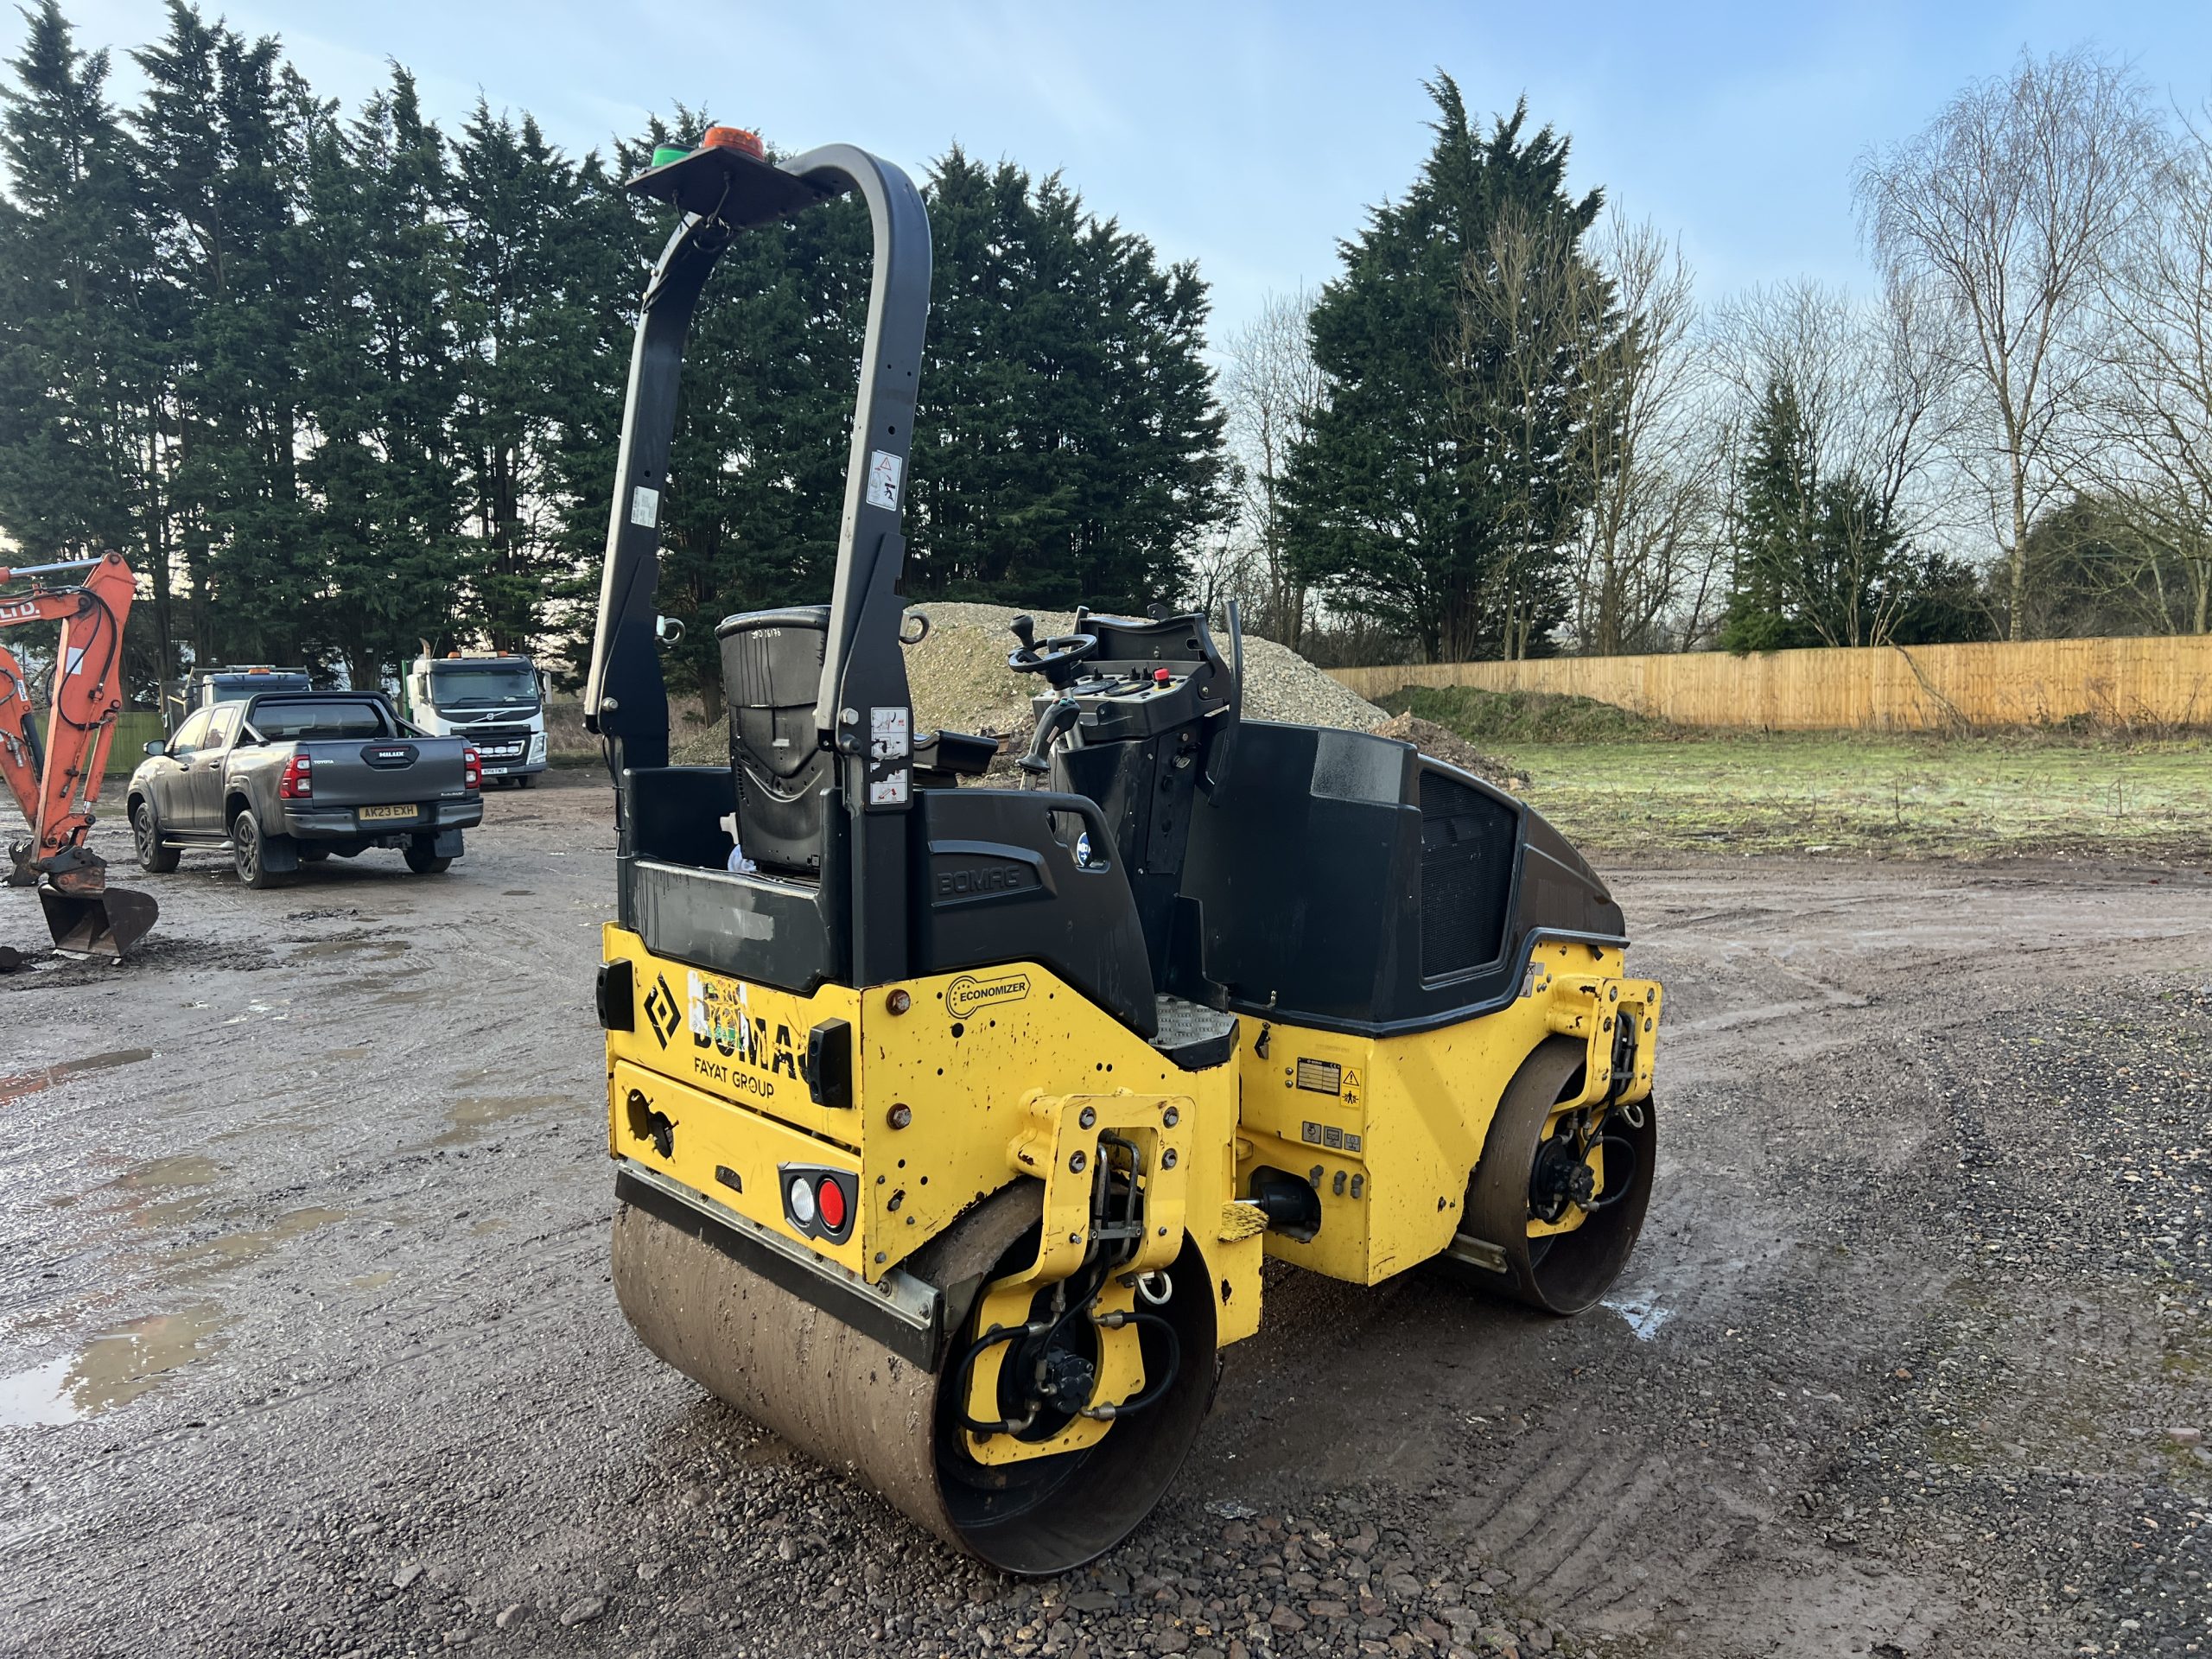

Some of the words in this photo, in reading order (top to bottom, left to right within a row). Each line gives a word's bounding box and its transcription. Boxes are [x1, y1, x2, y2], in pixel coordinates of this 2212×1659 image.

[0, 601, 40, 619] LTD.
[365, 807, 391, 818] AK23
[393, 805, 414, 817] EXH
[937, 865, 1020, 896] BOMAG
[959, 982, 1026, 1002] ECONOMIZER
[695, 1058, 728, 1084] FAYAT
[732, 1071, 774, 1099] GROUP
